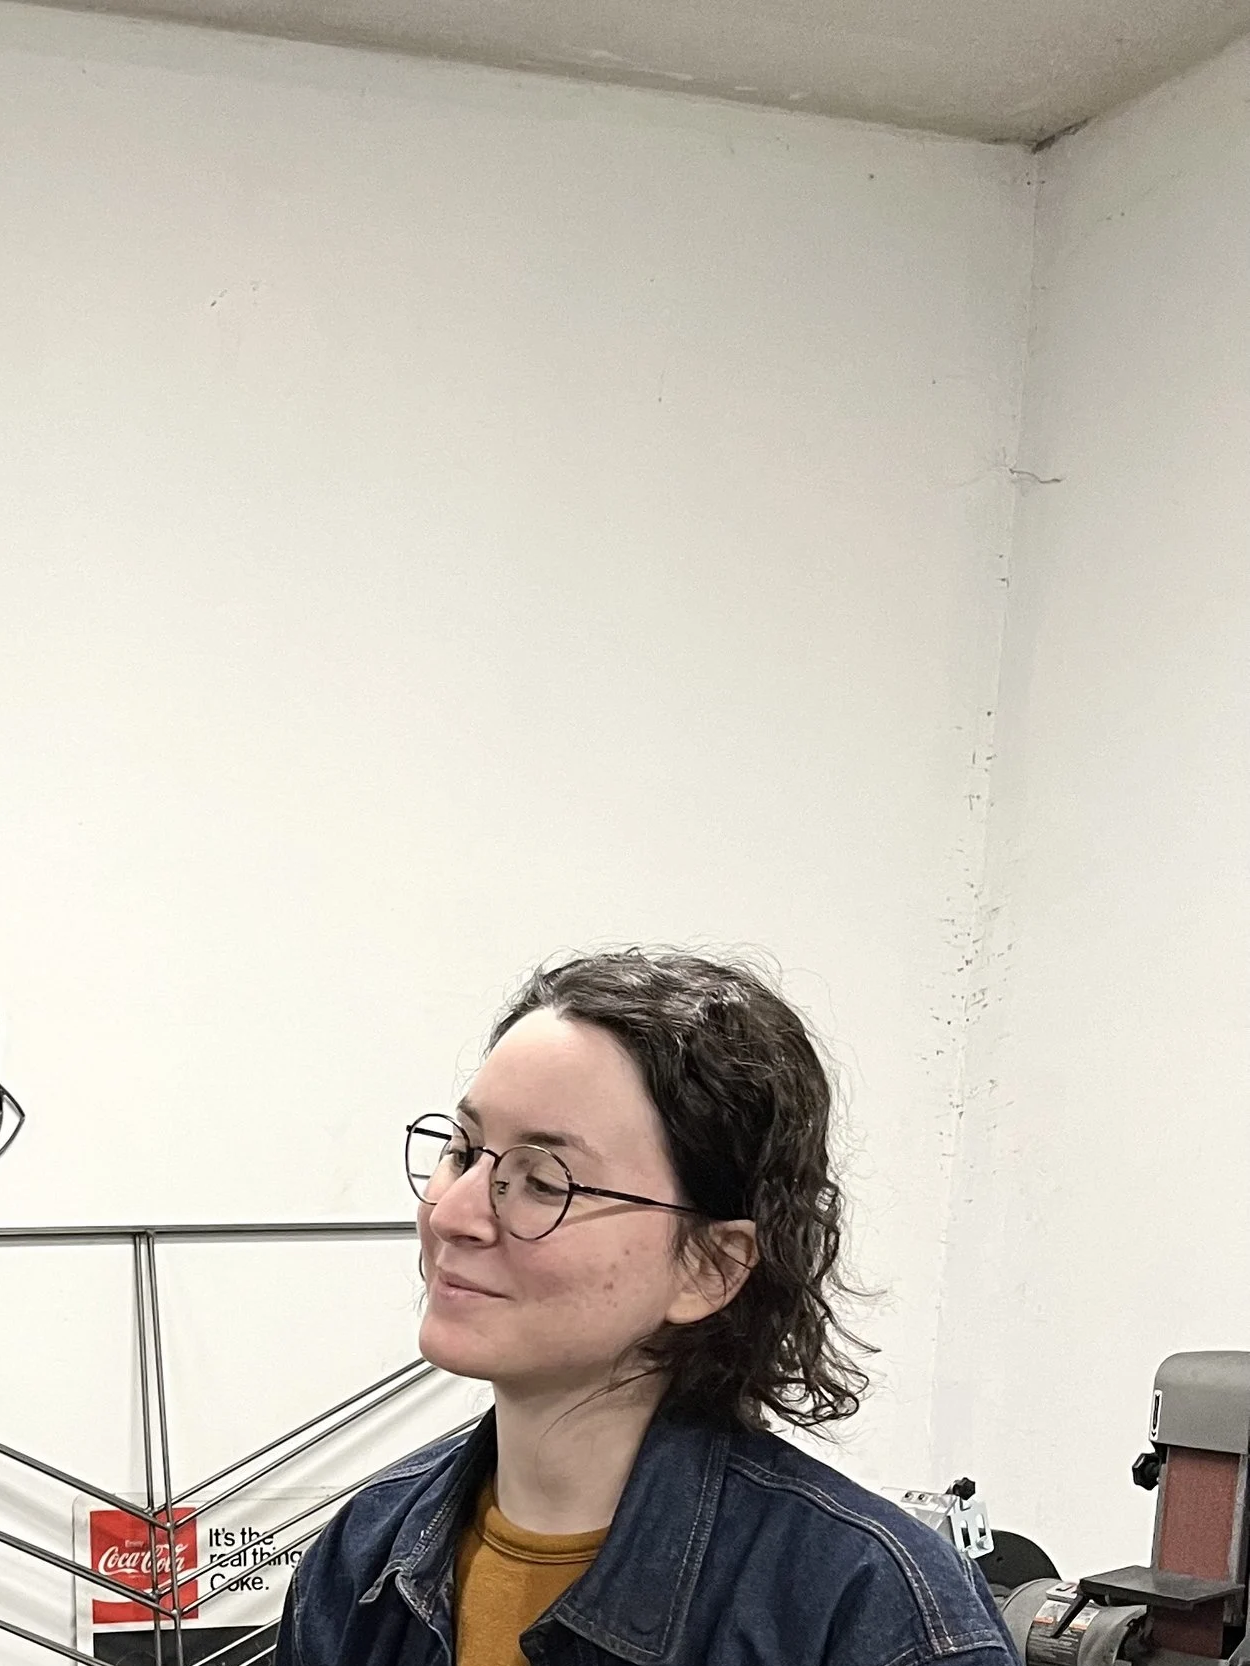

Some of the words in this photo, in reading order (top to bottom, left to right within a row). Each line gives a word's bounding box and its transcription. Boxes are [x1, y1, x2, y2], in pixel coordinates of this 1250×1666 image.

[209, 1527, 236, 1547] It's
[240, 1526, 274, 1546] the
[98, 1543, 189, 1576] Coca-Cola
[210, 1549, 247, 1568] real
[210, 1573, 269, 1592] Coke.
